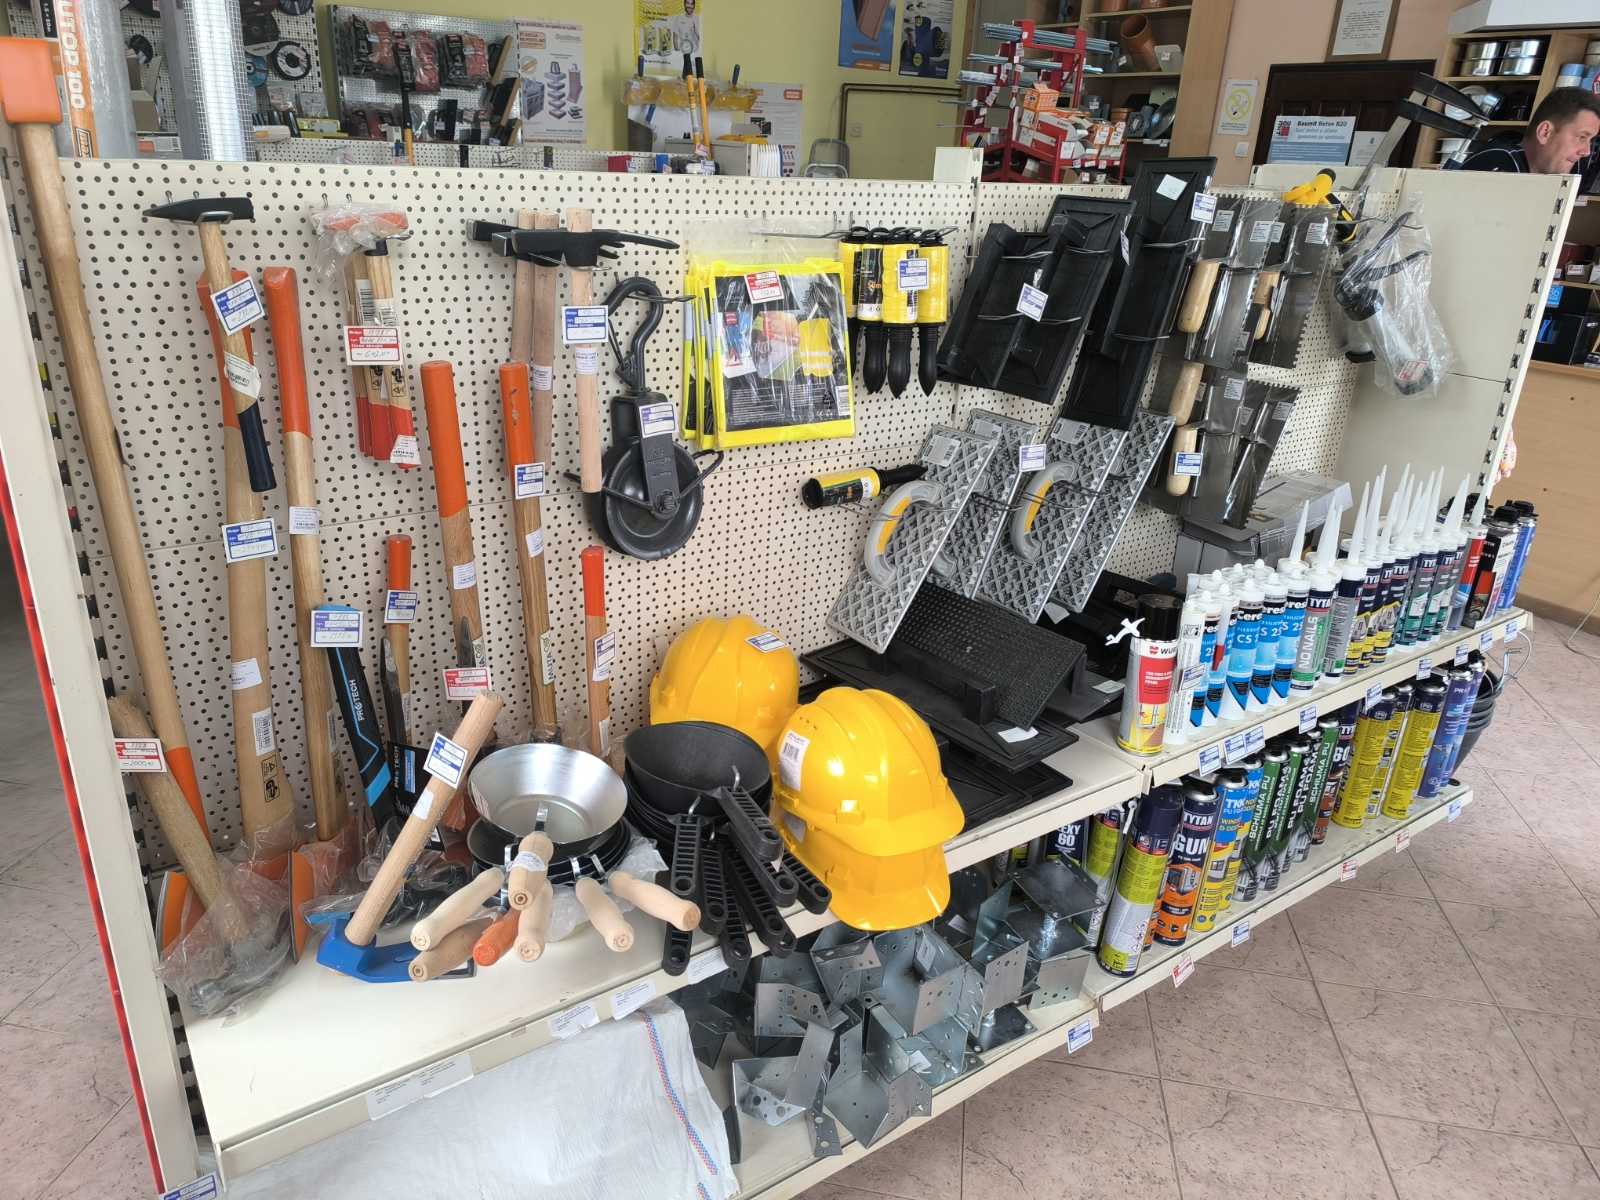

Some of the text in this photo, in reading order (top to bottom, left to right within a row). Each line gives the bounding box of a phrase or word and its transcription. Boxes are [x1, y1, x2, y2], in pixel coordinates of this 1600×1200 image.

[67, 71, 86, 110] 100
[1299, 616, 1319, 669] NO NAILS
[1309, 742, 1330, 803] SCHIUMA PU
[1057, 824, 1081, 835] EXY
[1183, 811, 1214, 826] TYTAN
[1248, 775, 1271, 839] SCHIUMA PU
